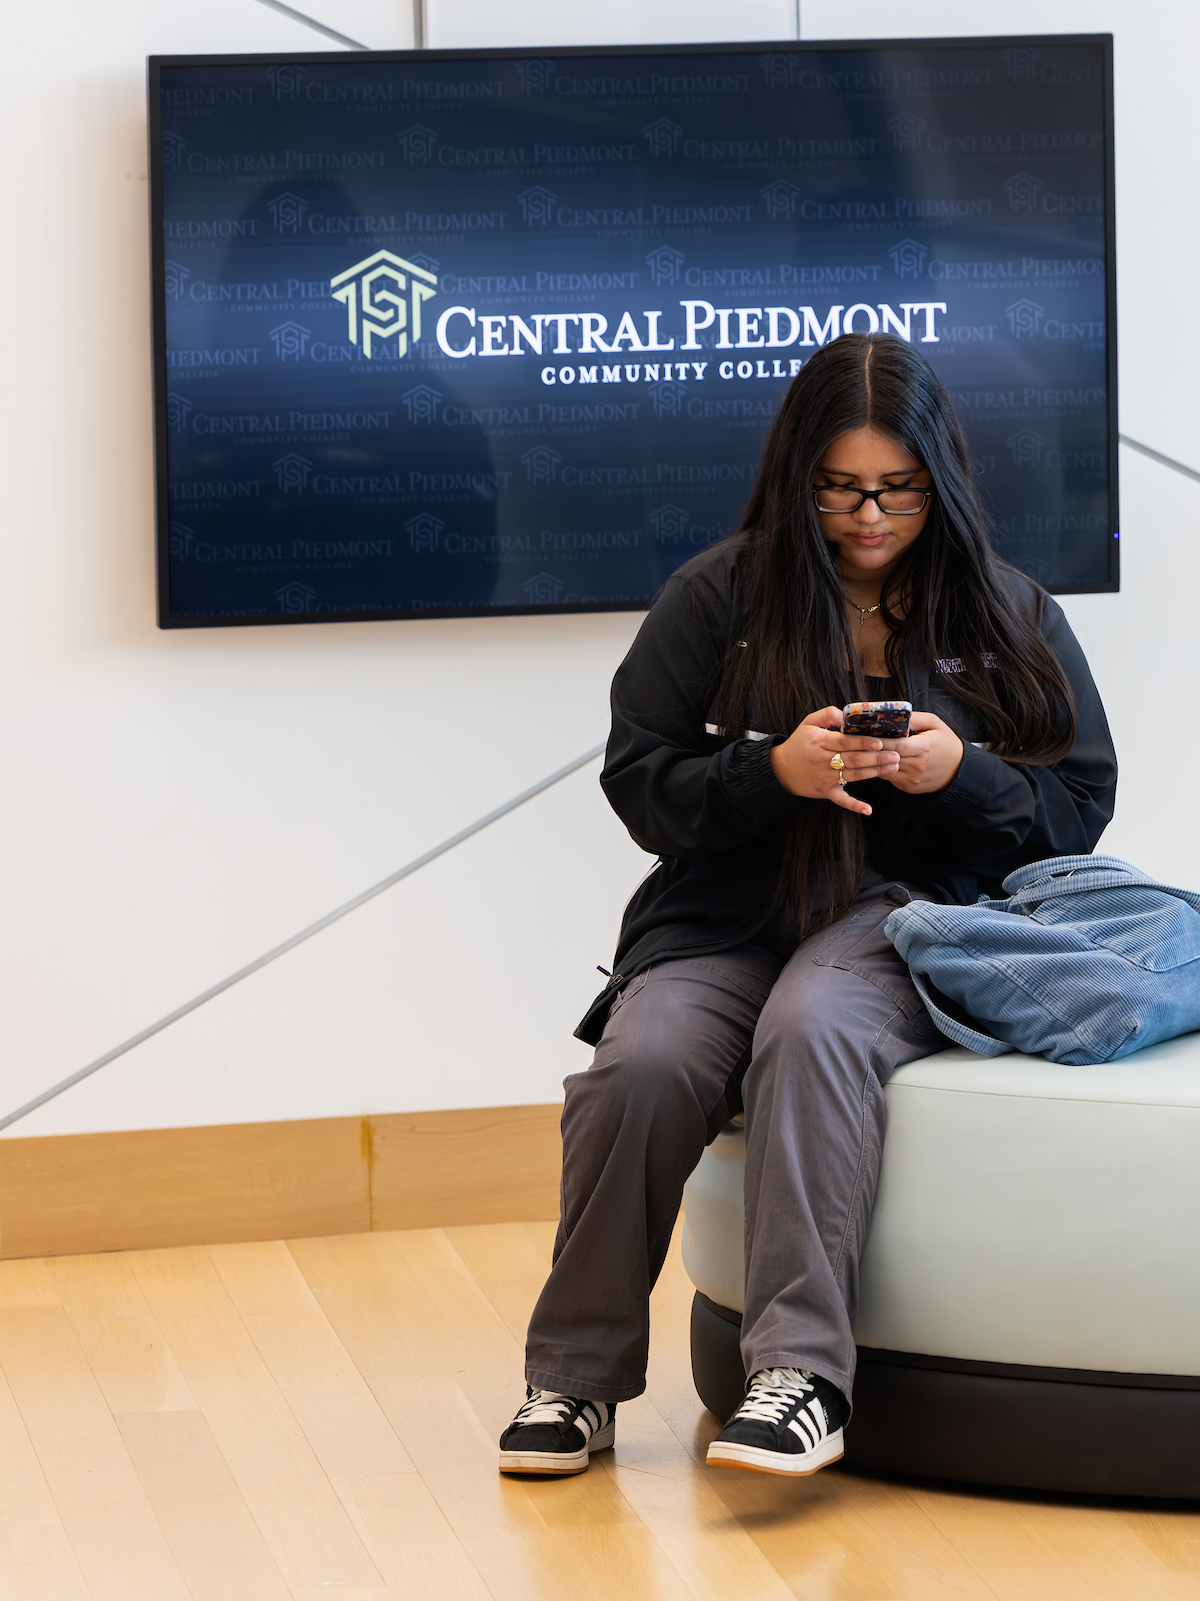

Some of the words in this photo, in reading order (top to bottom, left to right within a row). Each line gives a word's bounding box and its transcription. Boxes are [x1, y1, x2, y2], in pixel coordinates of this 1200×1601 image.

[162, 86, 257, 106] IEDMONT
[557, 206, 649, 228] CENTRAL
[652, 203, 756, 225] PIEDMONT
[800, 199, 892, 221] CENTRAL
[895, 196, 998, 218] PIEDMONT
[164, 218, 259, 239] IEDMONT
[308, 213, 401, 235] CENTRAL
[404, 210, 509, 232] PIEDMONT
[684, 266, 776, 288] CENTRAL
[779, 263, 882, 285] PIEDMONT
[928, 259, 1019, 280] CENTRAL
[1022, 256, 1104, 277] PIEDMON
[190, 280, 284, 302] CENTRAL
[440, 273, 533, 295] CENTRAL
[536, 270, 640, 292] PIEDMONT
[436, 306, 675, 359] CENTRAL
[680, 299, 947, 350] PIEDMONT
[167, 347, 261, 368] IEDMONT
[540, 362, 708, 385] COMMUNITY
[718, 359, 803, 380] COLLE
[947, 390, 1020, 410] ENTRAL
[192, 412, 286, 435] CENTRAL
[289, 409, 394, 431] PIEDMONT
[442, 405, 535, 426] CENTRAL
[538, 402, 642, 423] PIEDMONT
[312, 473, 406, 494] CENTRAL
[409, 470, 513, 491] PIEDMONT
[561, 465, 653, 486] CENTRAL
[169, 479, 264, 499] IEDMONT
